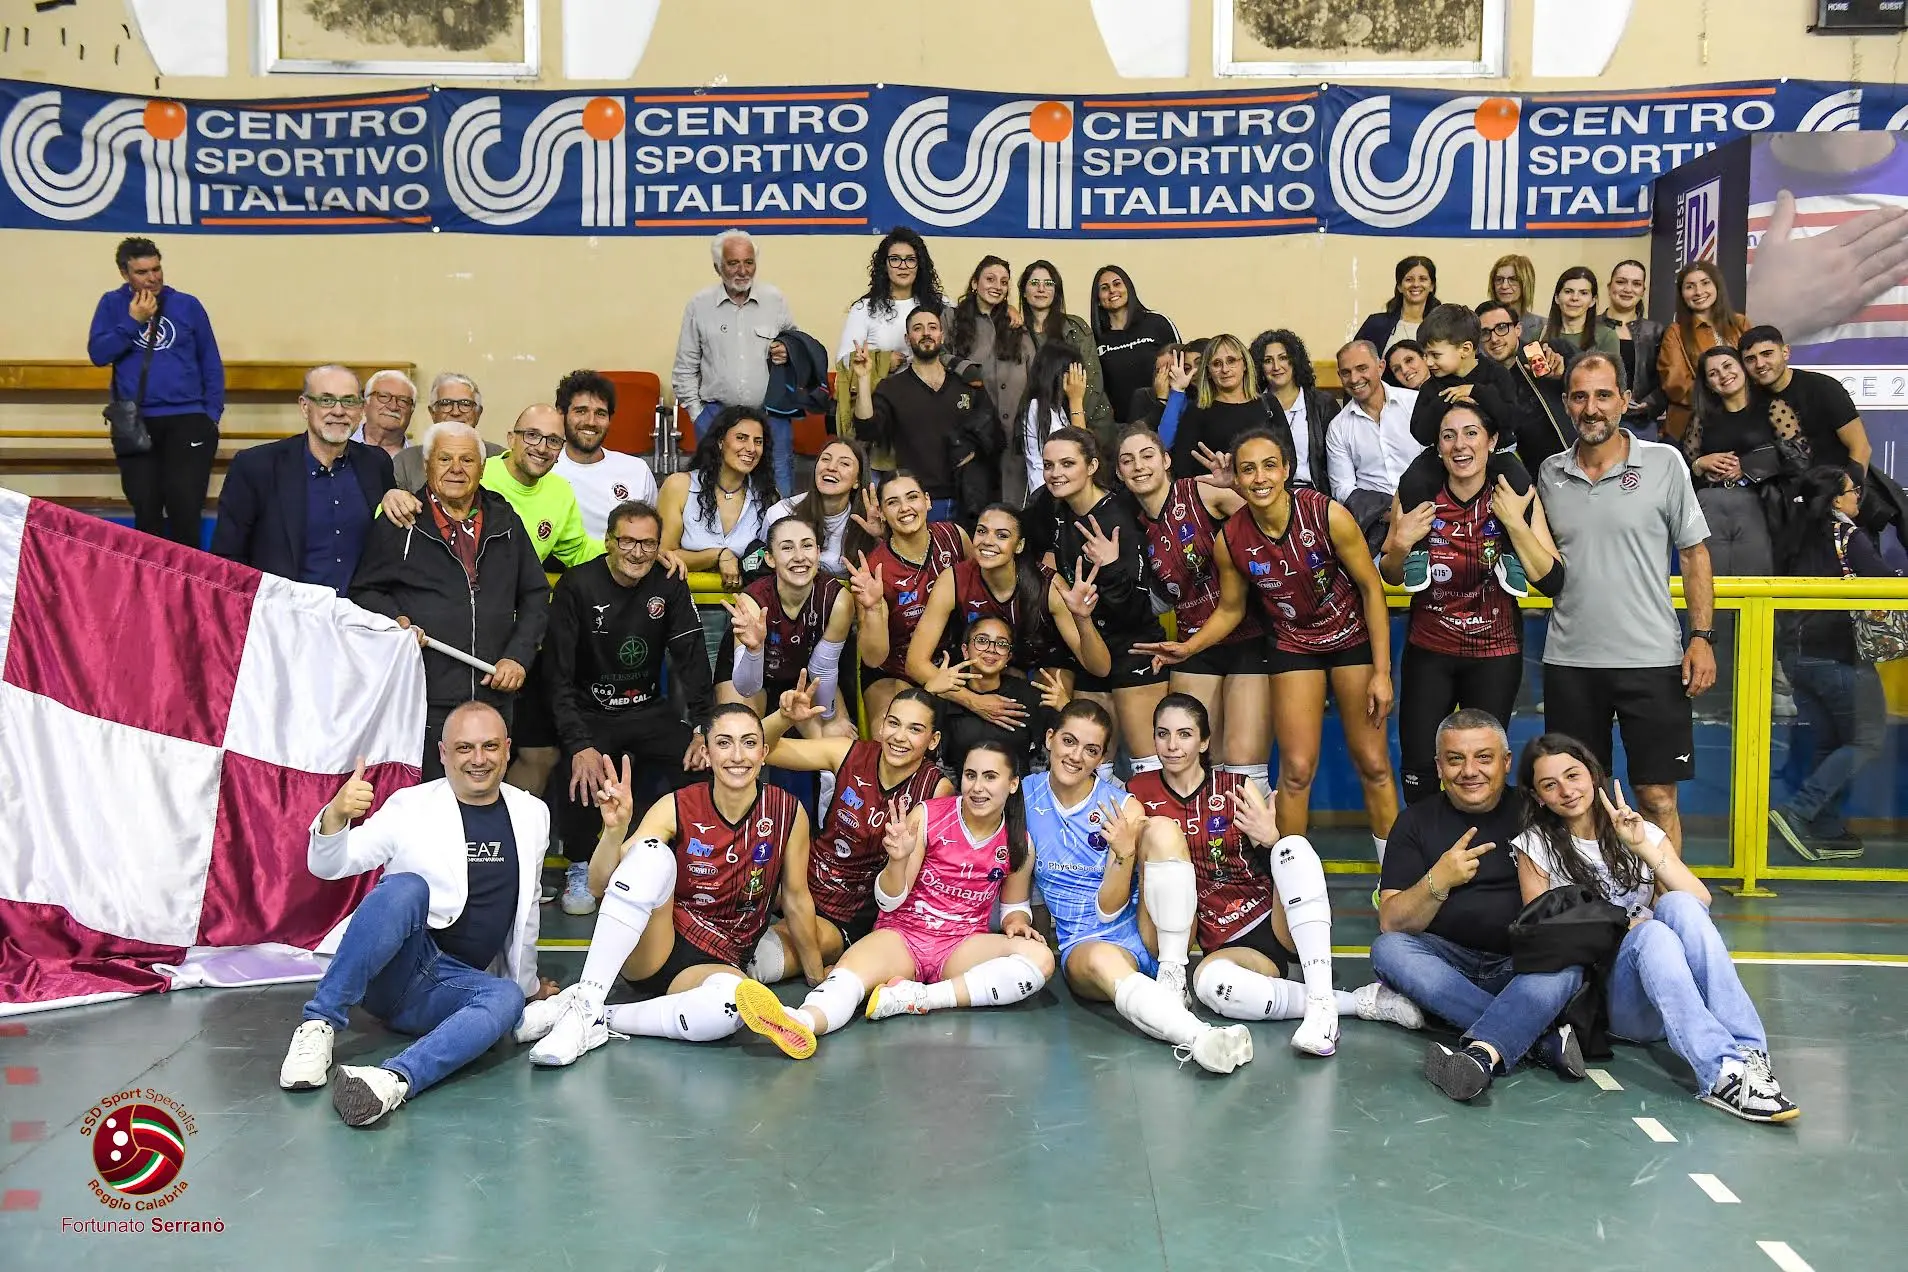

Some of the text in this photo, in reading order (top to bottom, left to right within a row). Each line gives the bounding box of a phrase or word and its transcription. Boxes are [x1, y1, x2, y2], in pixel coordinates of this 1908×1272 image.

[1827, 2, 1904, 11] HOME GUEST
[198, 107, 428, 140] CENTRO
[634, 103, 869, 137] CENTRO
[1081, 104, 1316, 140] CENTRO
[1529, 100, 1776, 136] CENTRO
[194, 144, 429, 177] SPORTIVO
[634, 142, 868, 175] SPORTIVO
[1081, 142, 1315, 176] SPORTIVO
[200, 182, 431, 212] ITALIANO
[635, 182, 868, 213] ITALIANO
[1081, 182, 1315, 216] ITALIANO
[1097, 336, 1155, 356] Champion
[1451, 521, 1473, 537] 21
[1160, 535, 1171, 551] 3
[1279, 559, 1297, 576] 2
[790, 635, 801, 645] 9
[866, 806, 885, 828] 10
[466, 842, 502, 858] EA7
[725, 844, 739, 864] 6
[960, 862, 974, 880] 11
